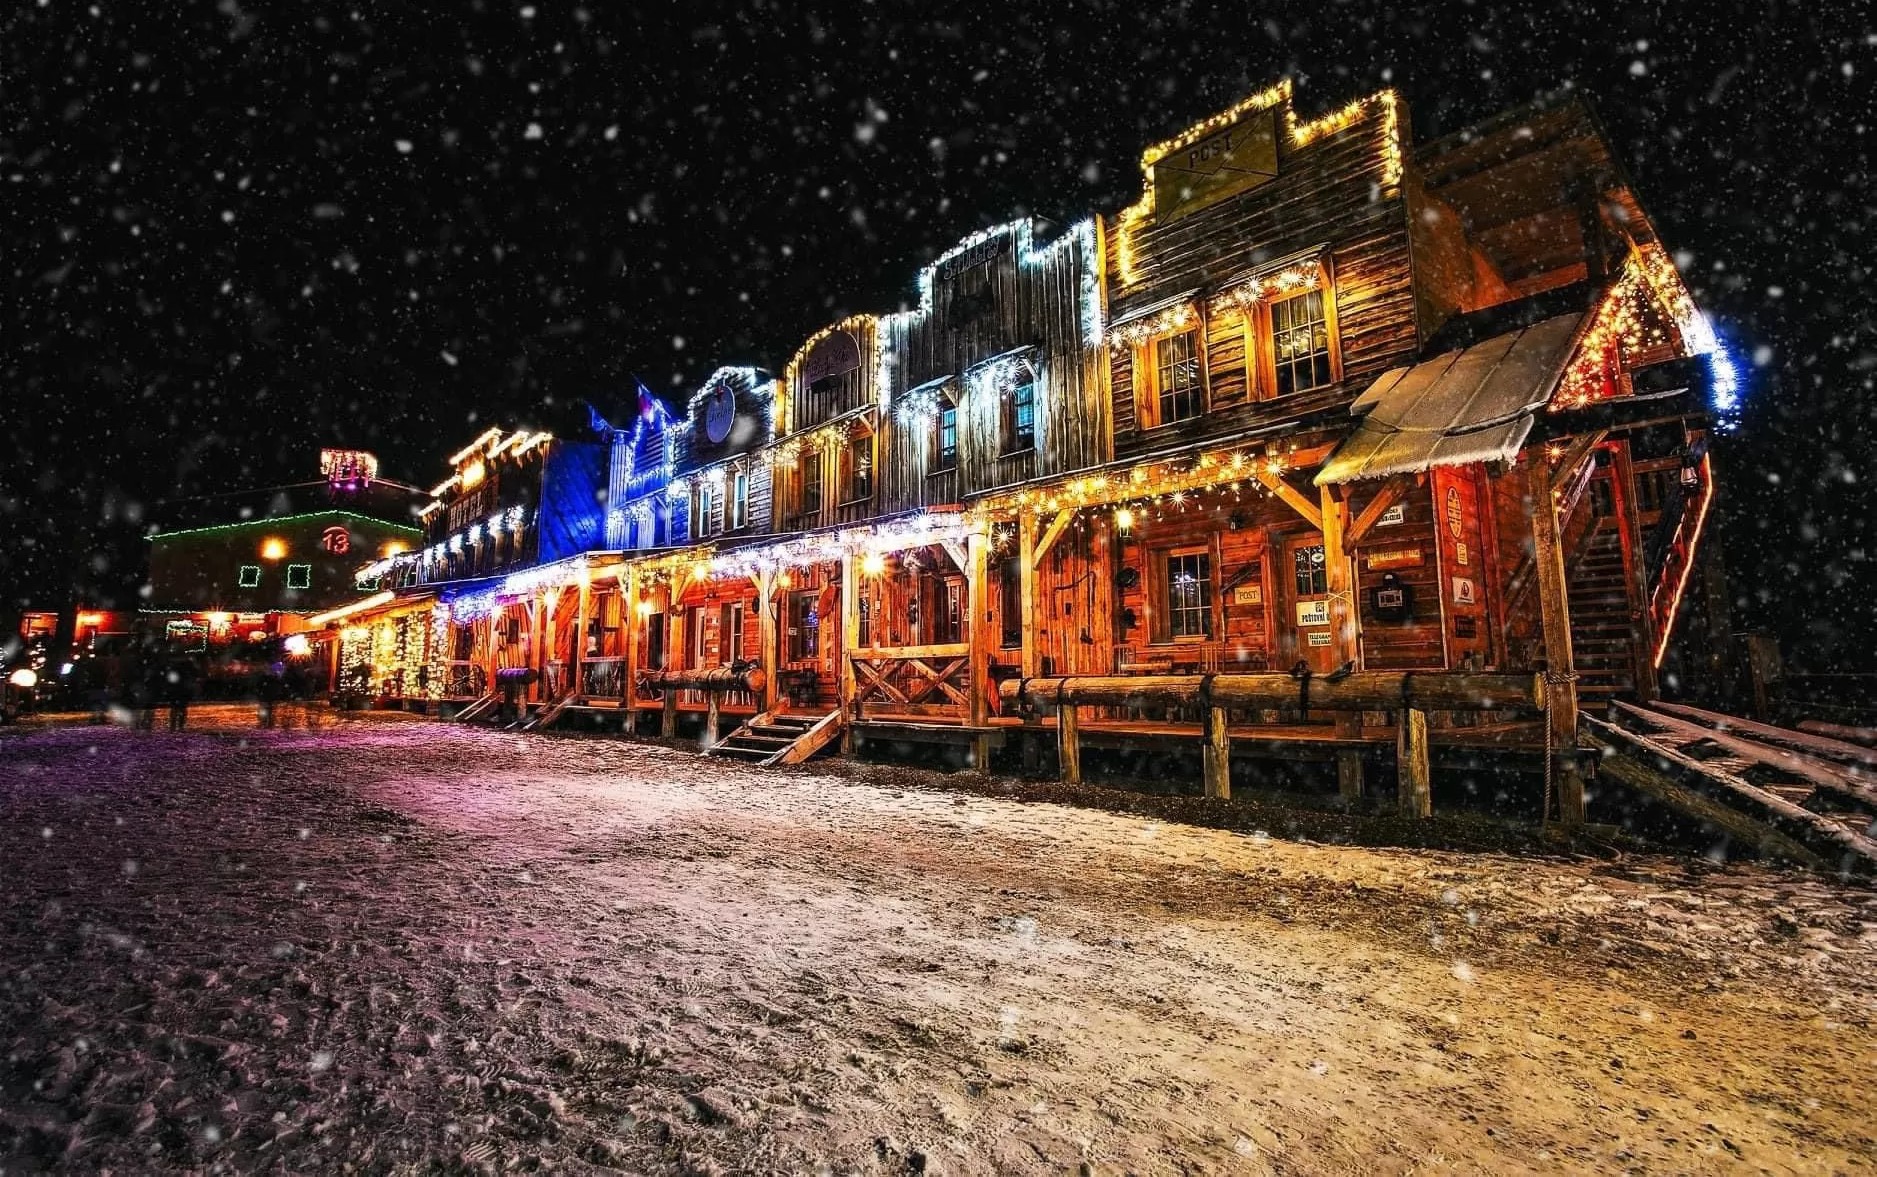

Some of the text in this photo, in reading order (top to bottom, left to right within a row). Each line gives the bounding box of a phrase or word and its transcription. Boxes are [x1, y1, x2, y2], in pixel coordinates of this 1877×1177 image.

[1189, 134, 1233, 169] POST
[322, 533, 350, 554] 13
[1239, 590, 1258, 600] POST
